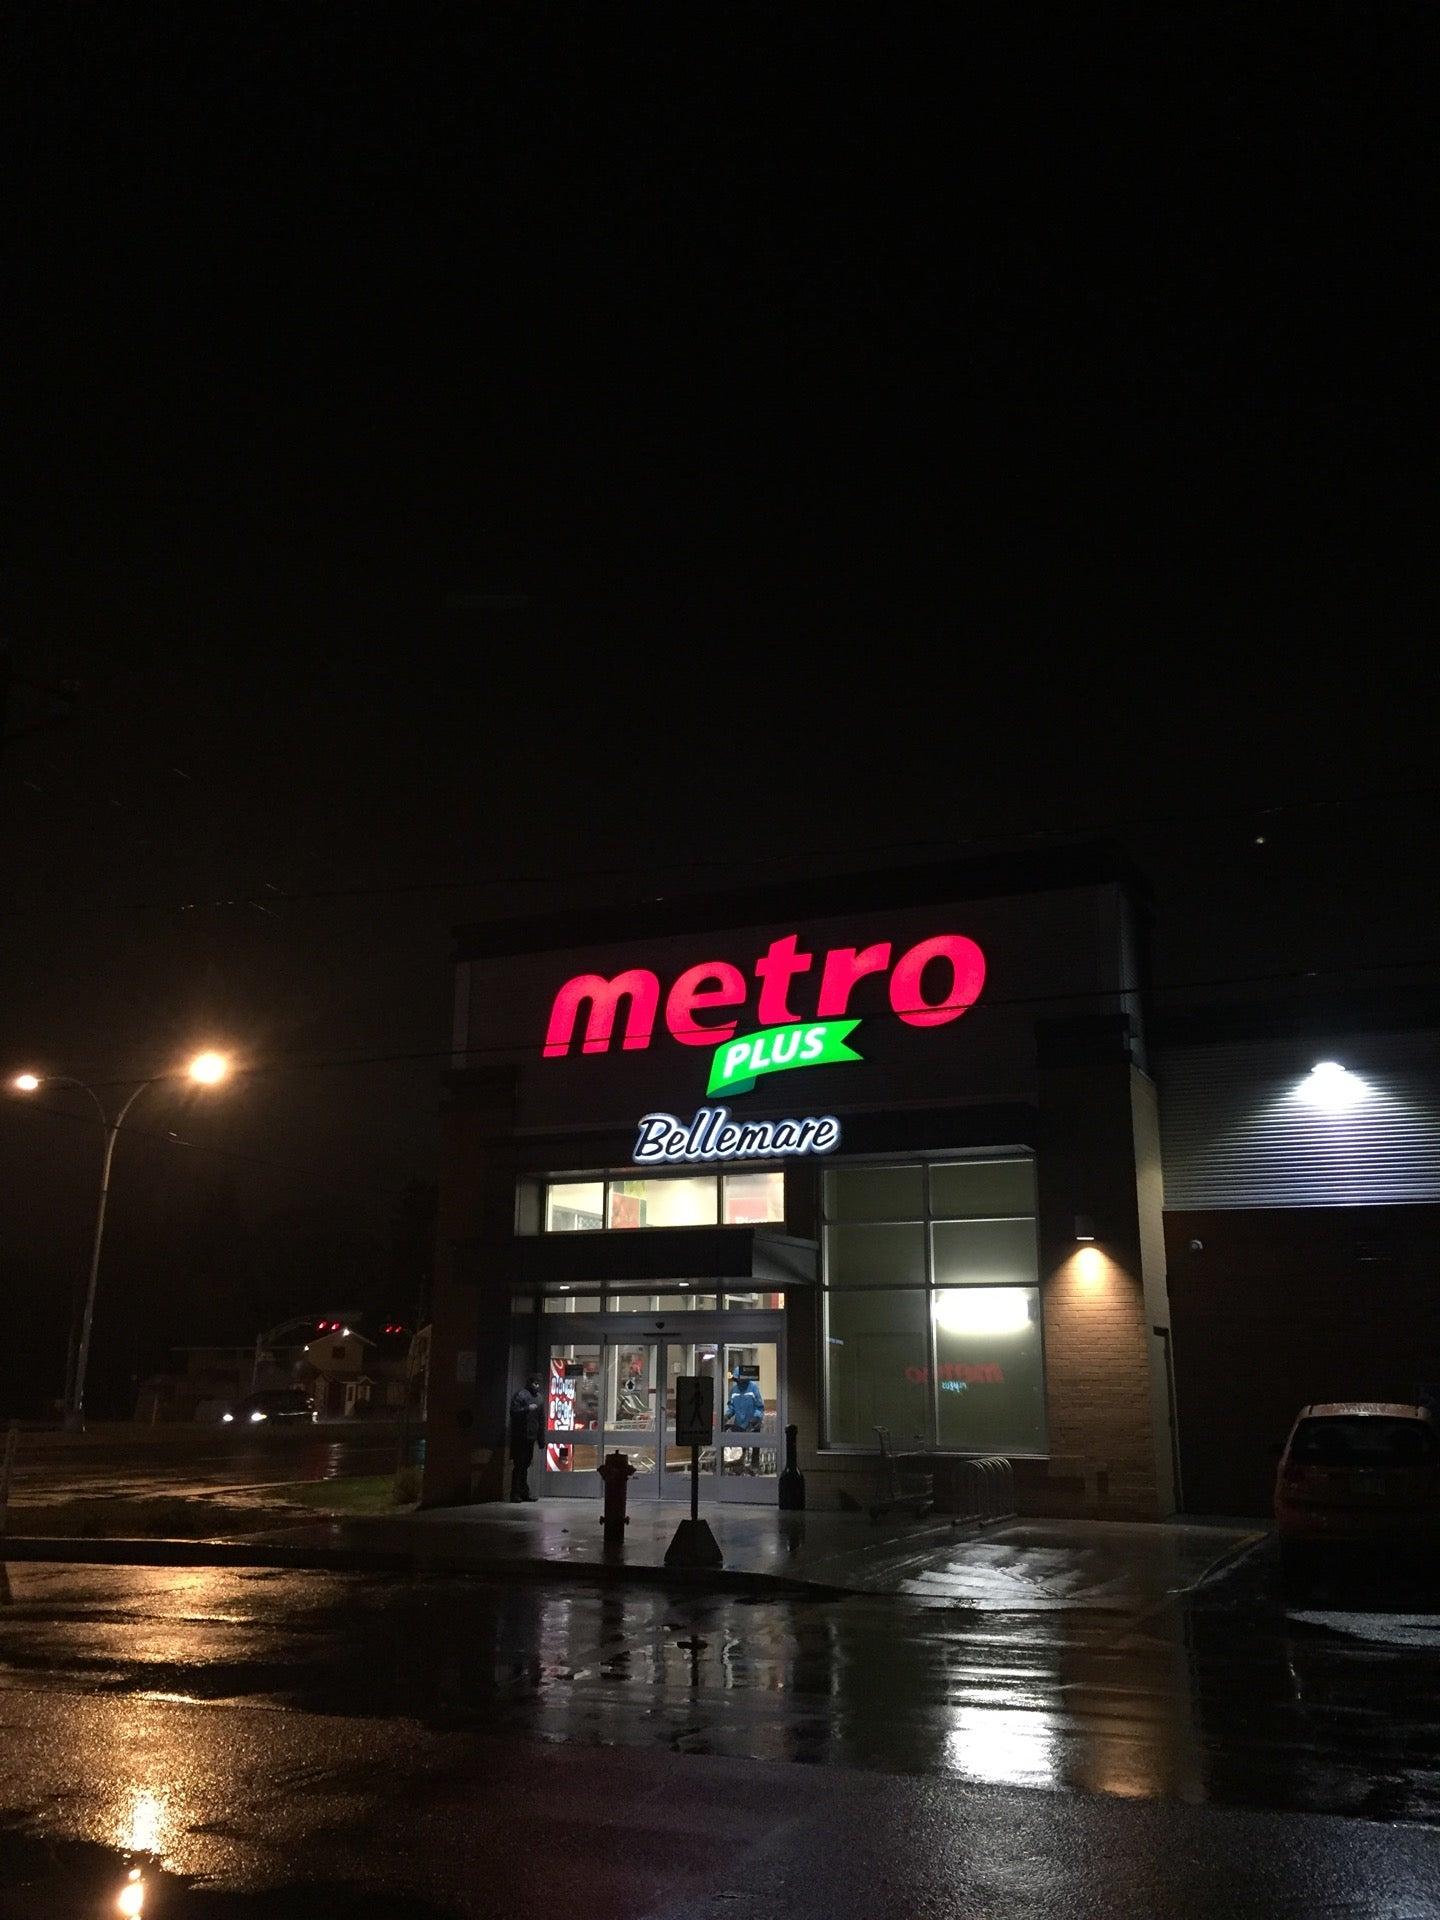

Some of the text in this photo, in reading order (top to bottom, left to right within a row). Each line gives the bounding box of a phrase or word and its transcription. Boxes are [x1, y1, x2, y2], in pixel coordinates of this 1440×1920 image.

[542, 934, 986, 1058] metro
[723, 1027, 827, 1078] PLUS
[634, 1108, 838, 1161] Bellemare
